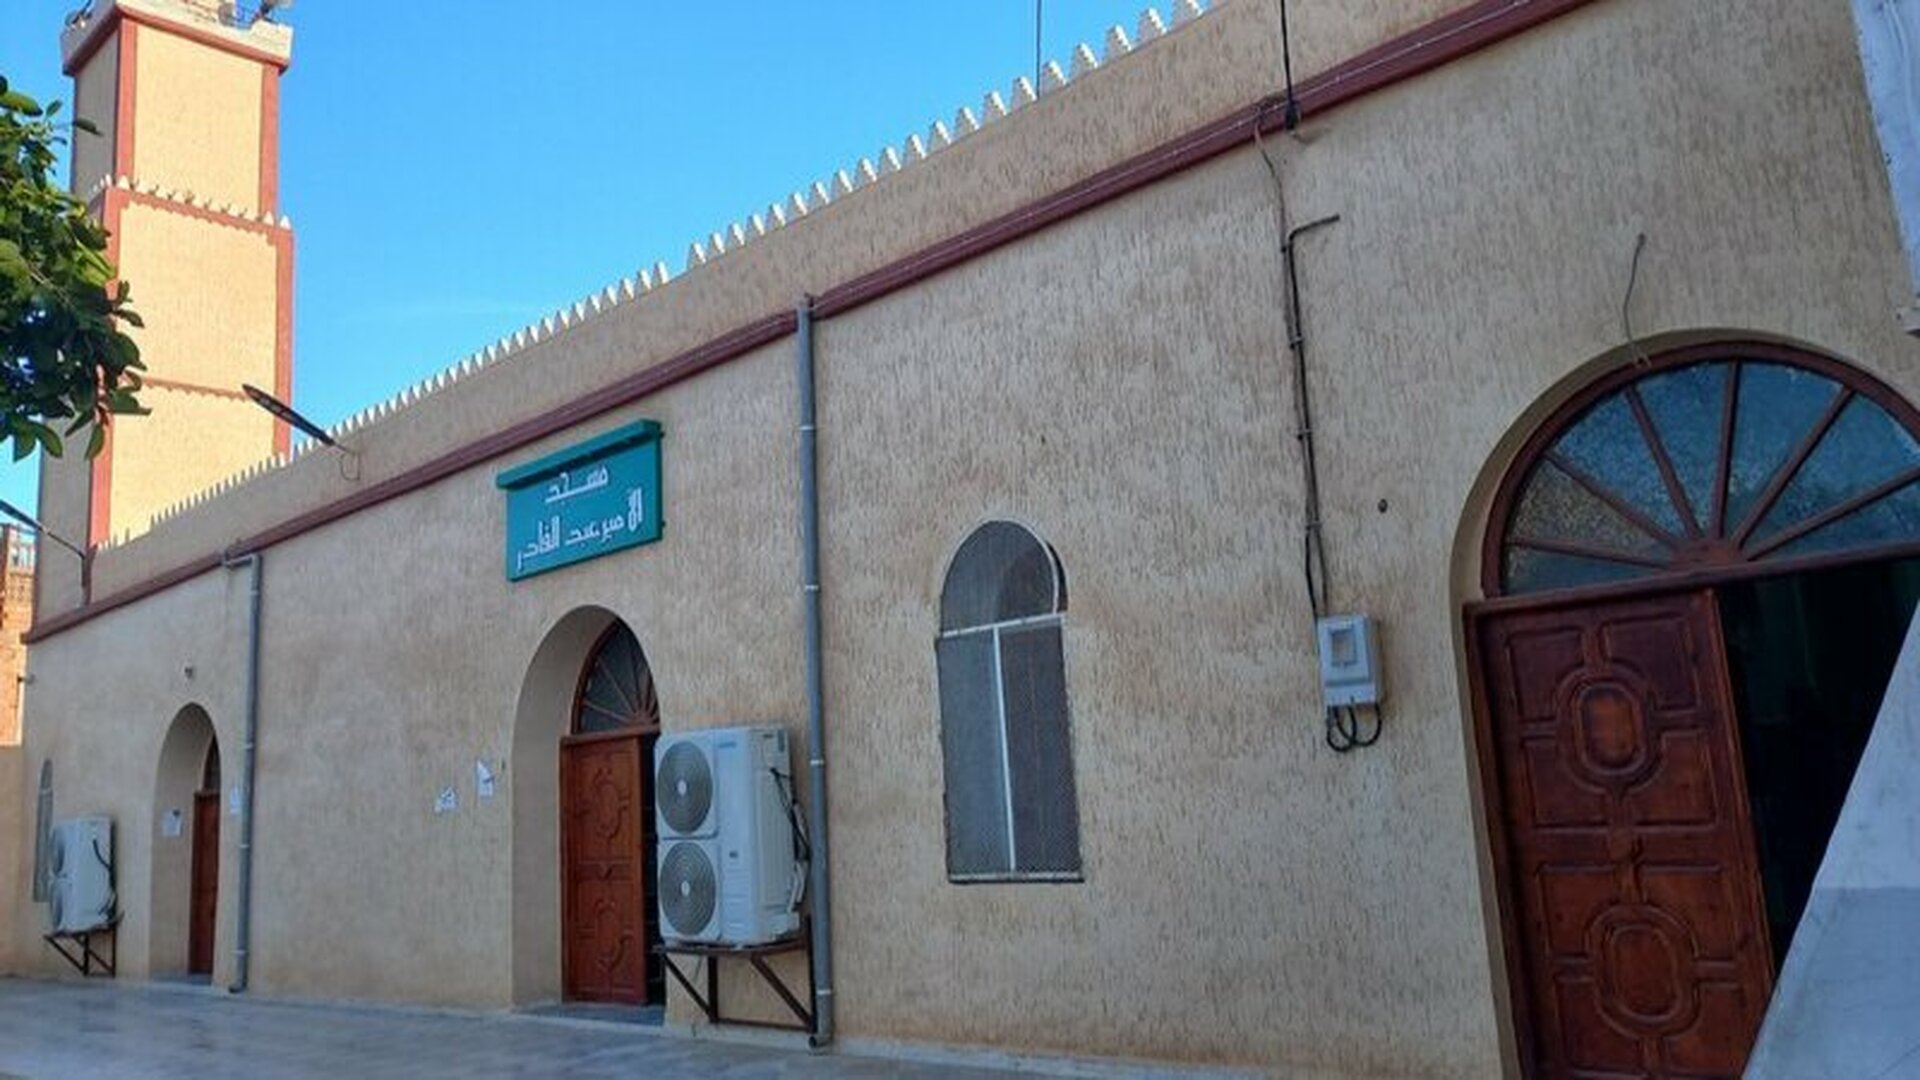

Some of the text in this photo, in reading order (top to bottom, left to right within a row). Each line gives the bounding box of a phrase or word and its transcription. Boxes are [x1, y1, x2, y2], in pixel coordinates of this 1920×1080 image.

[544, 466, 609, 504] مسجد
[517, 515, 560, 571] القادر
[564, 525, 600, 547] عبد
